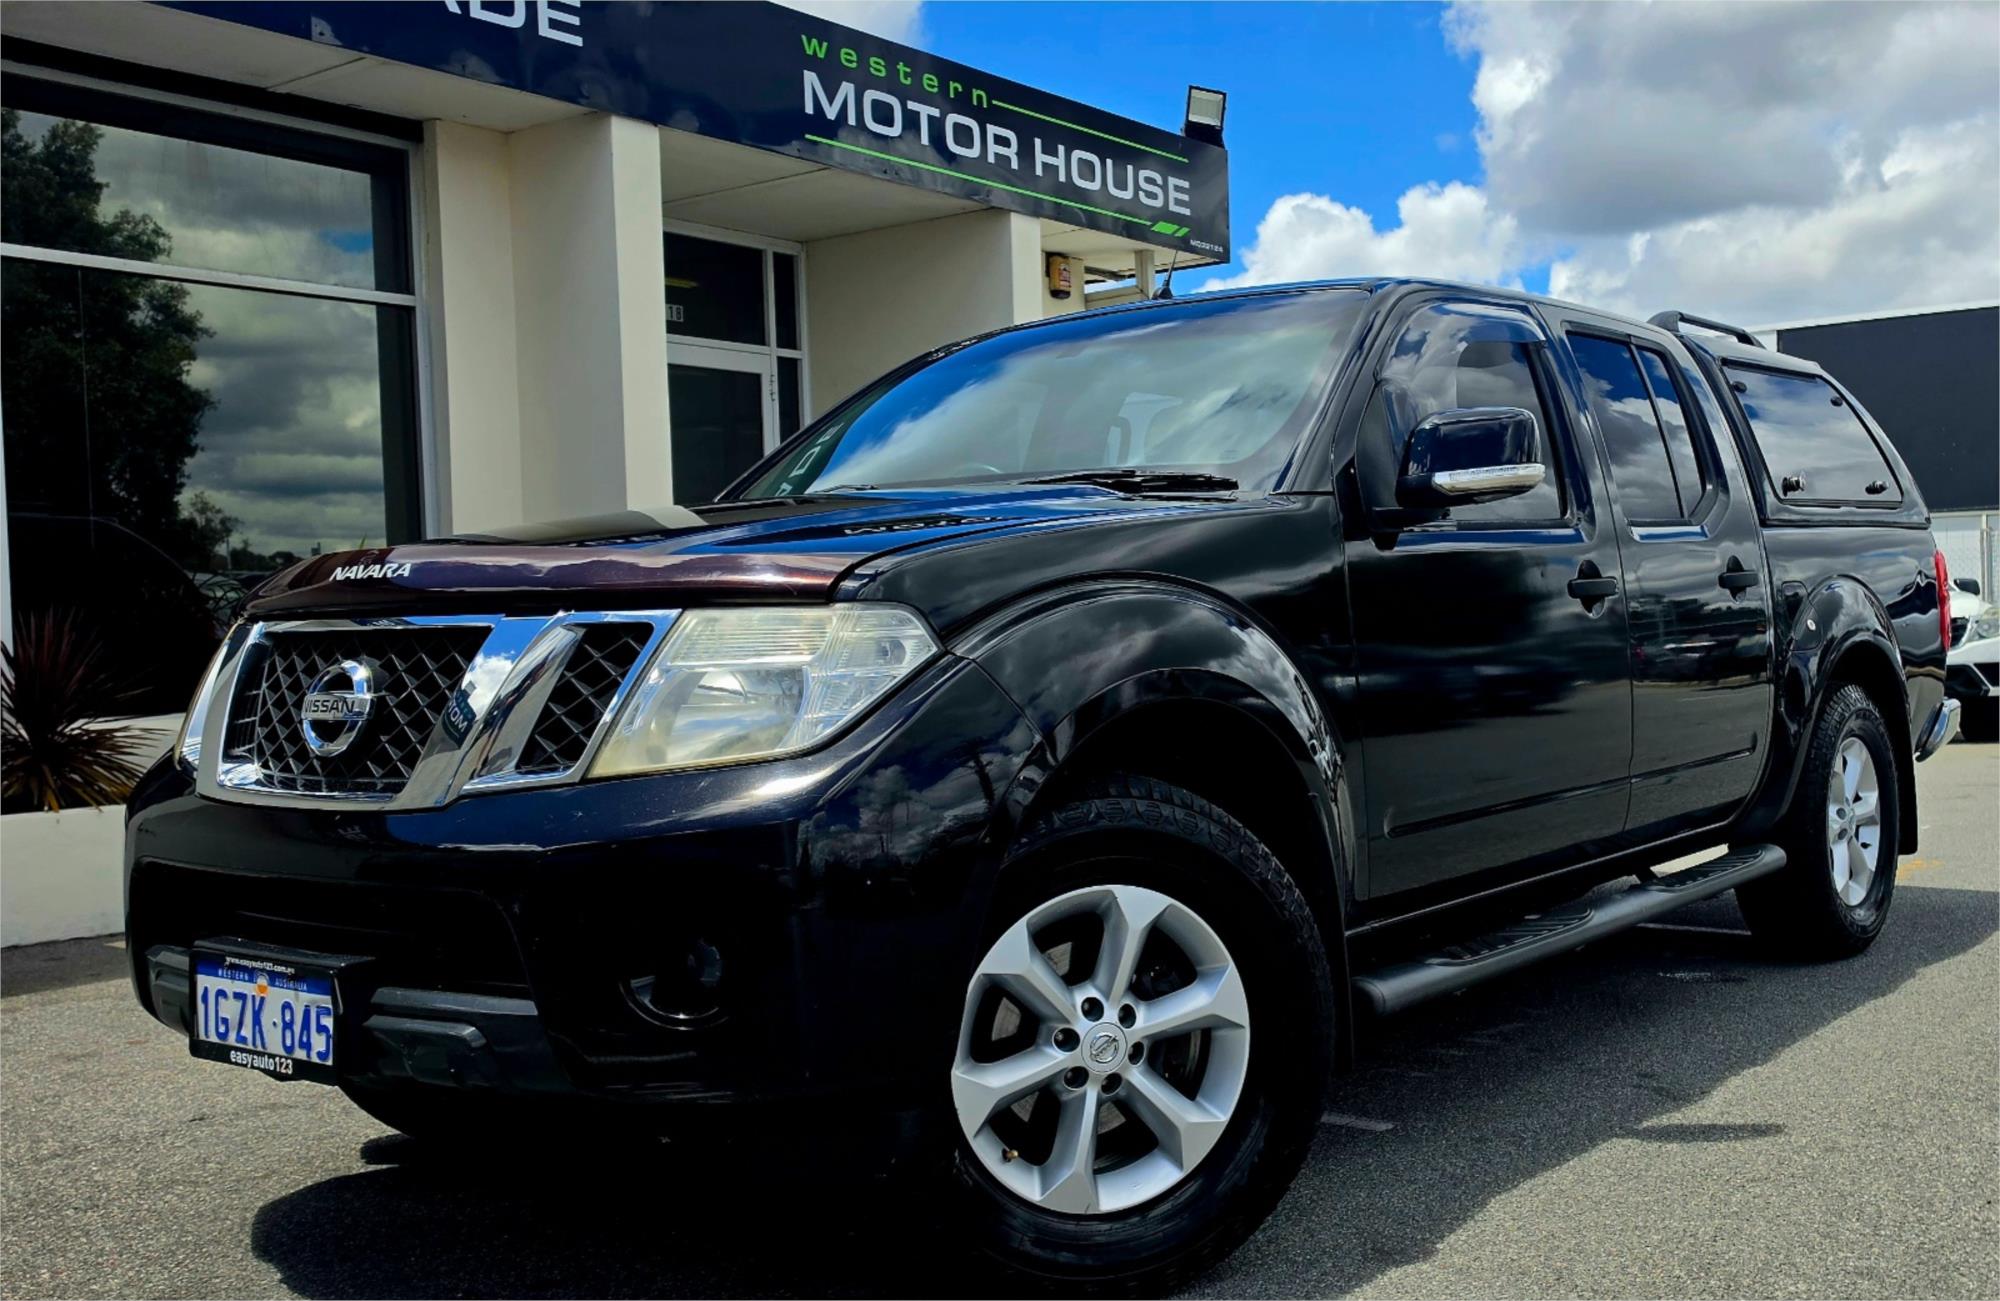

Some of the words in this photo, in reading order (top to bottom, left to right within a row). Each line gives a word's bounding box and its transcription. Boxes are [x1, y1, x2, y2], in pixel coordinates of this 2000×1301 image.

[801, 34, 988, 108] western
[802, 69, 1019, 171] MOTOR
[1033, 137, 1192, 216] HOUSE
[328, 562, 412, 582] NAVARA
[304, 698, 356, 714] NISSAN
[218, 967, 249, 981] WESTERN
[229, 1049, 293, 1075] easyauto123
